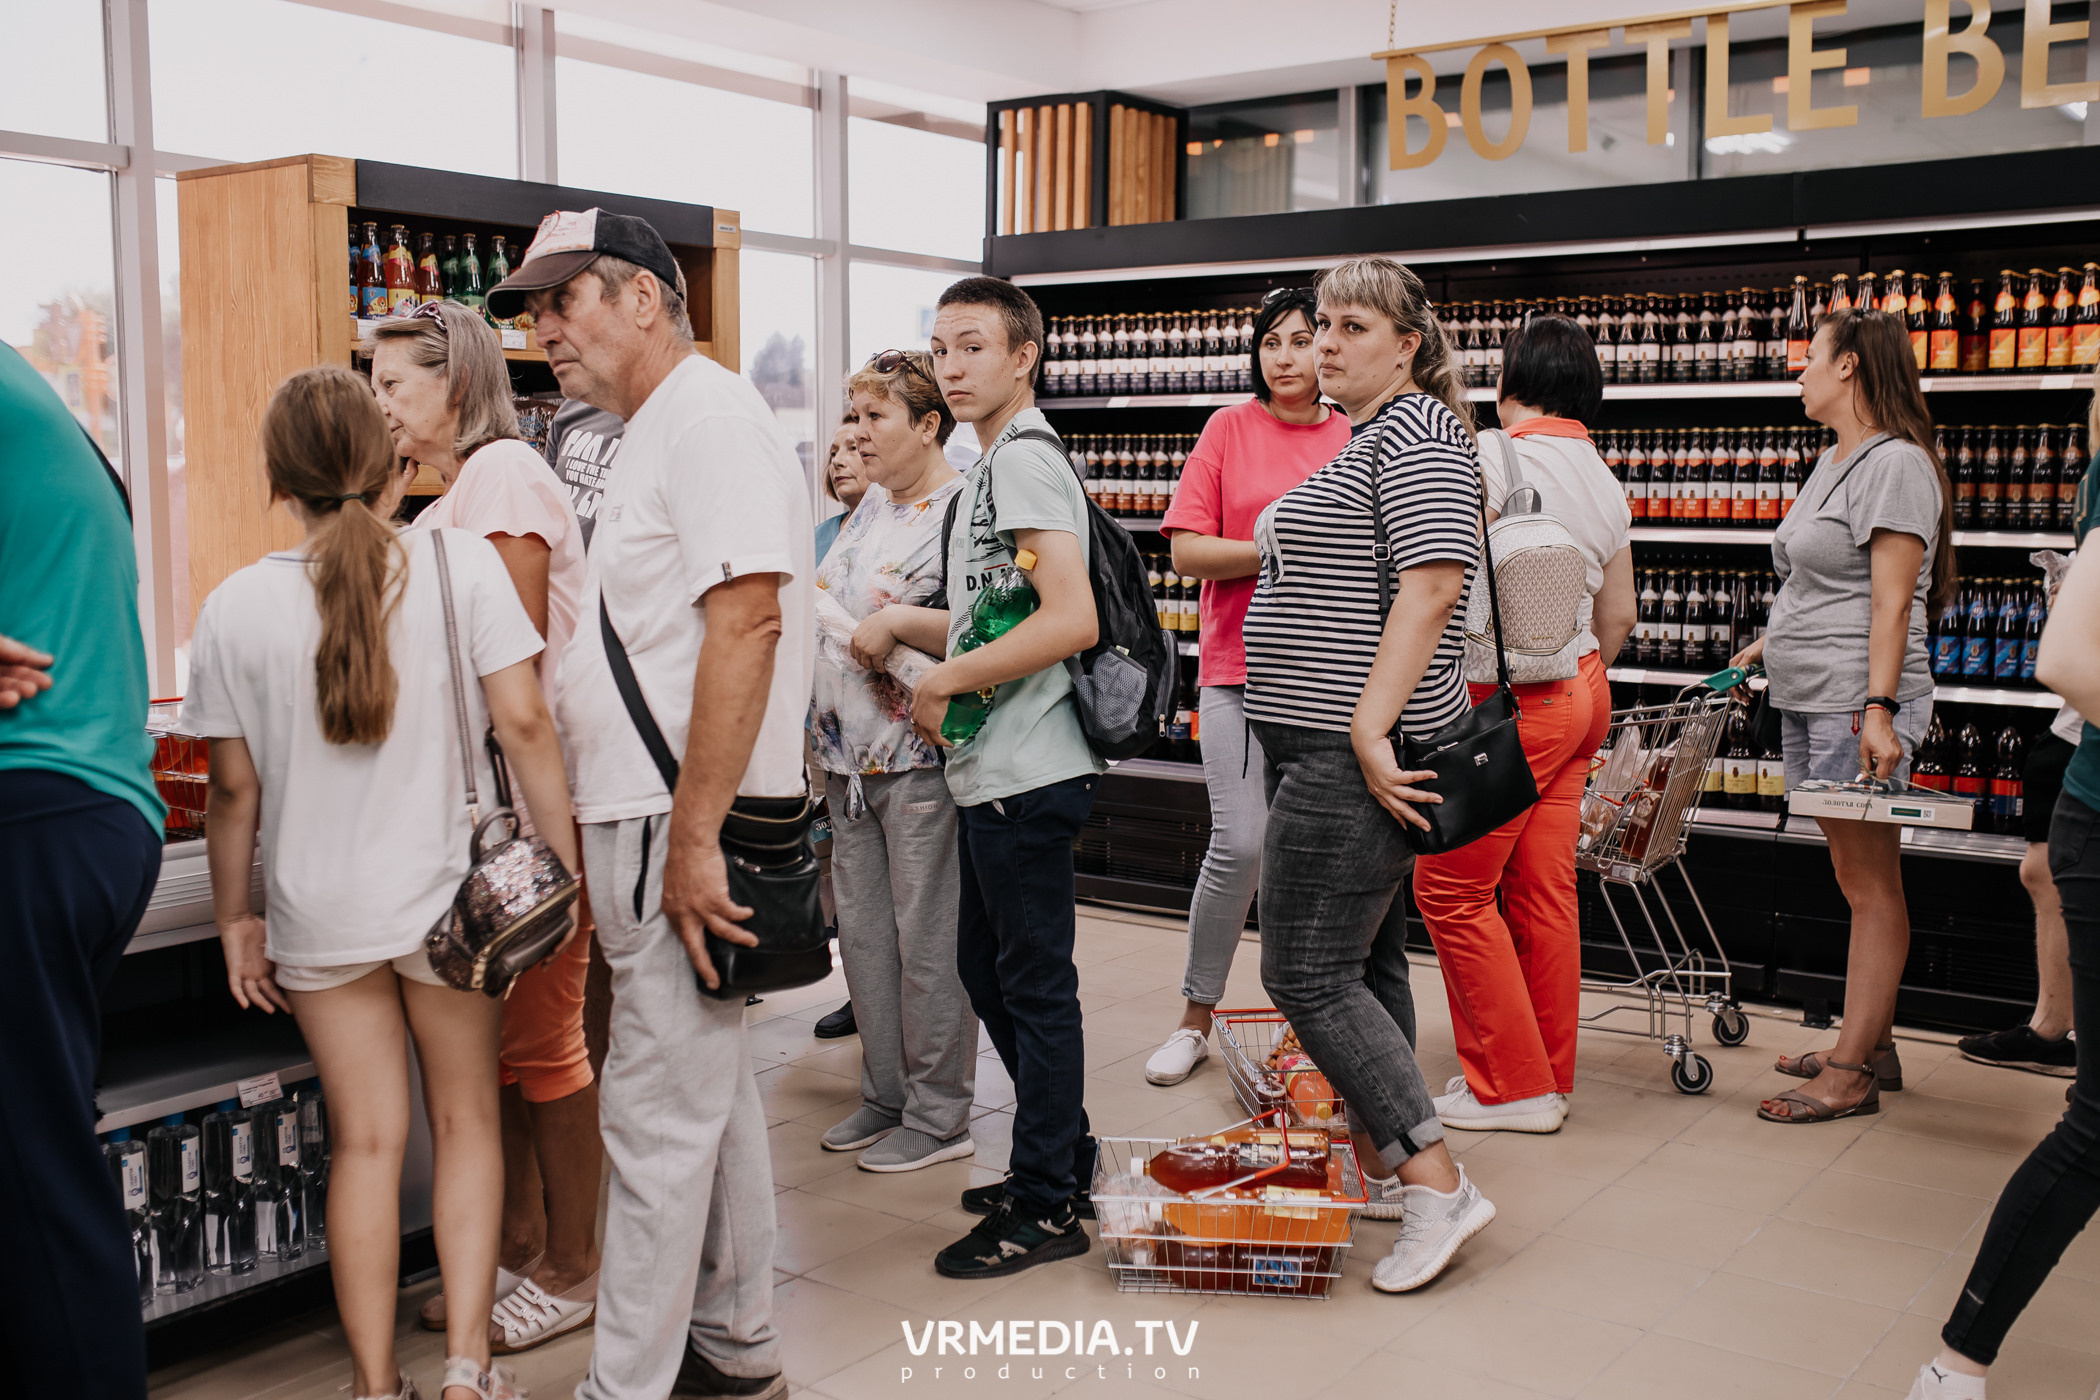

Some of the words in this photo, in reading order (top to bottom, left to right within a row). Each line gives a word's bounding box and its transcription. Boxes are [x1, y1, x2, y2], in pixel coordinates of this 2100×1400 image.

[1386, 0, 1858, 171] BOTTLE
[569, 459, 587, 473] LOVE
[566, 469, 580, 483] YOU
